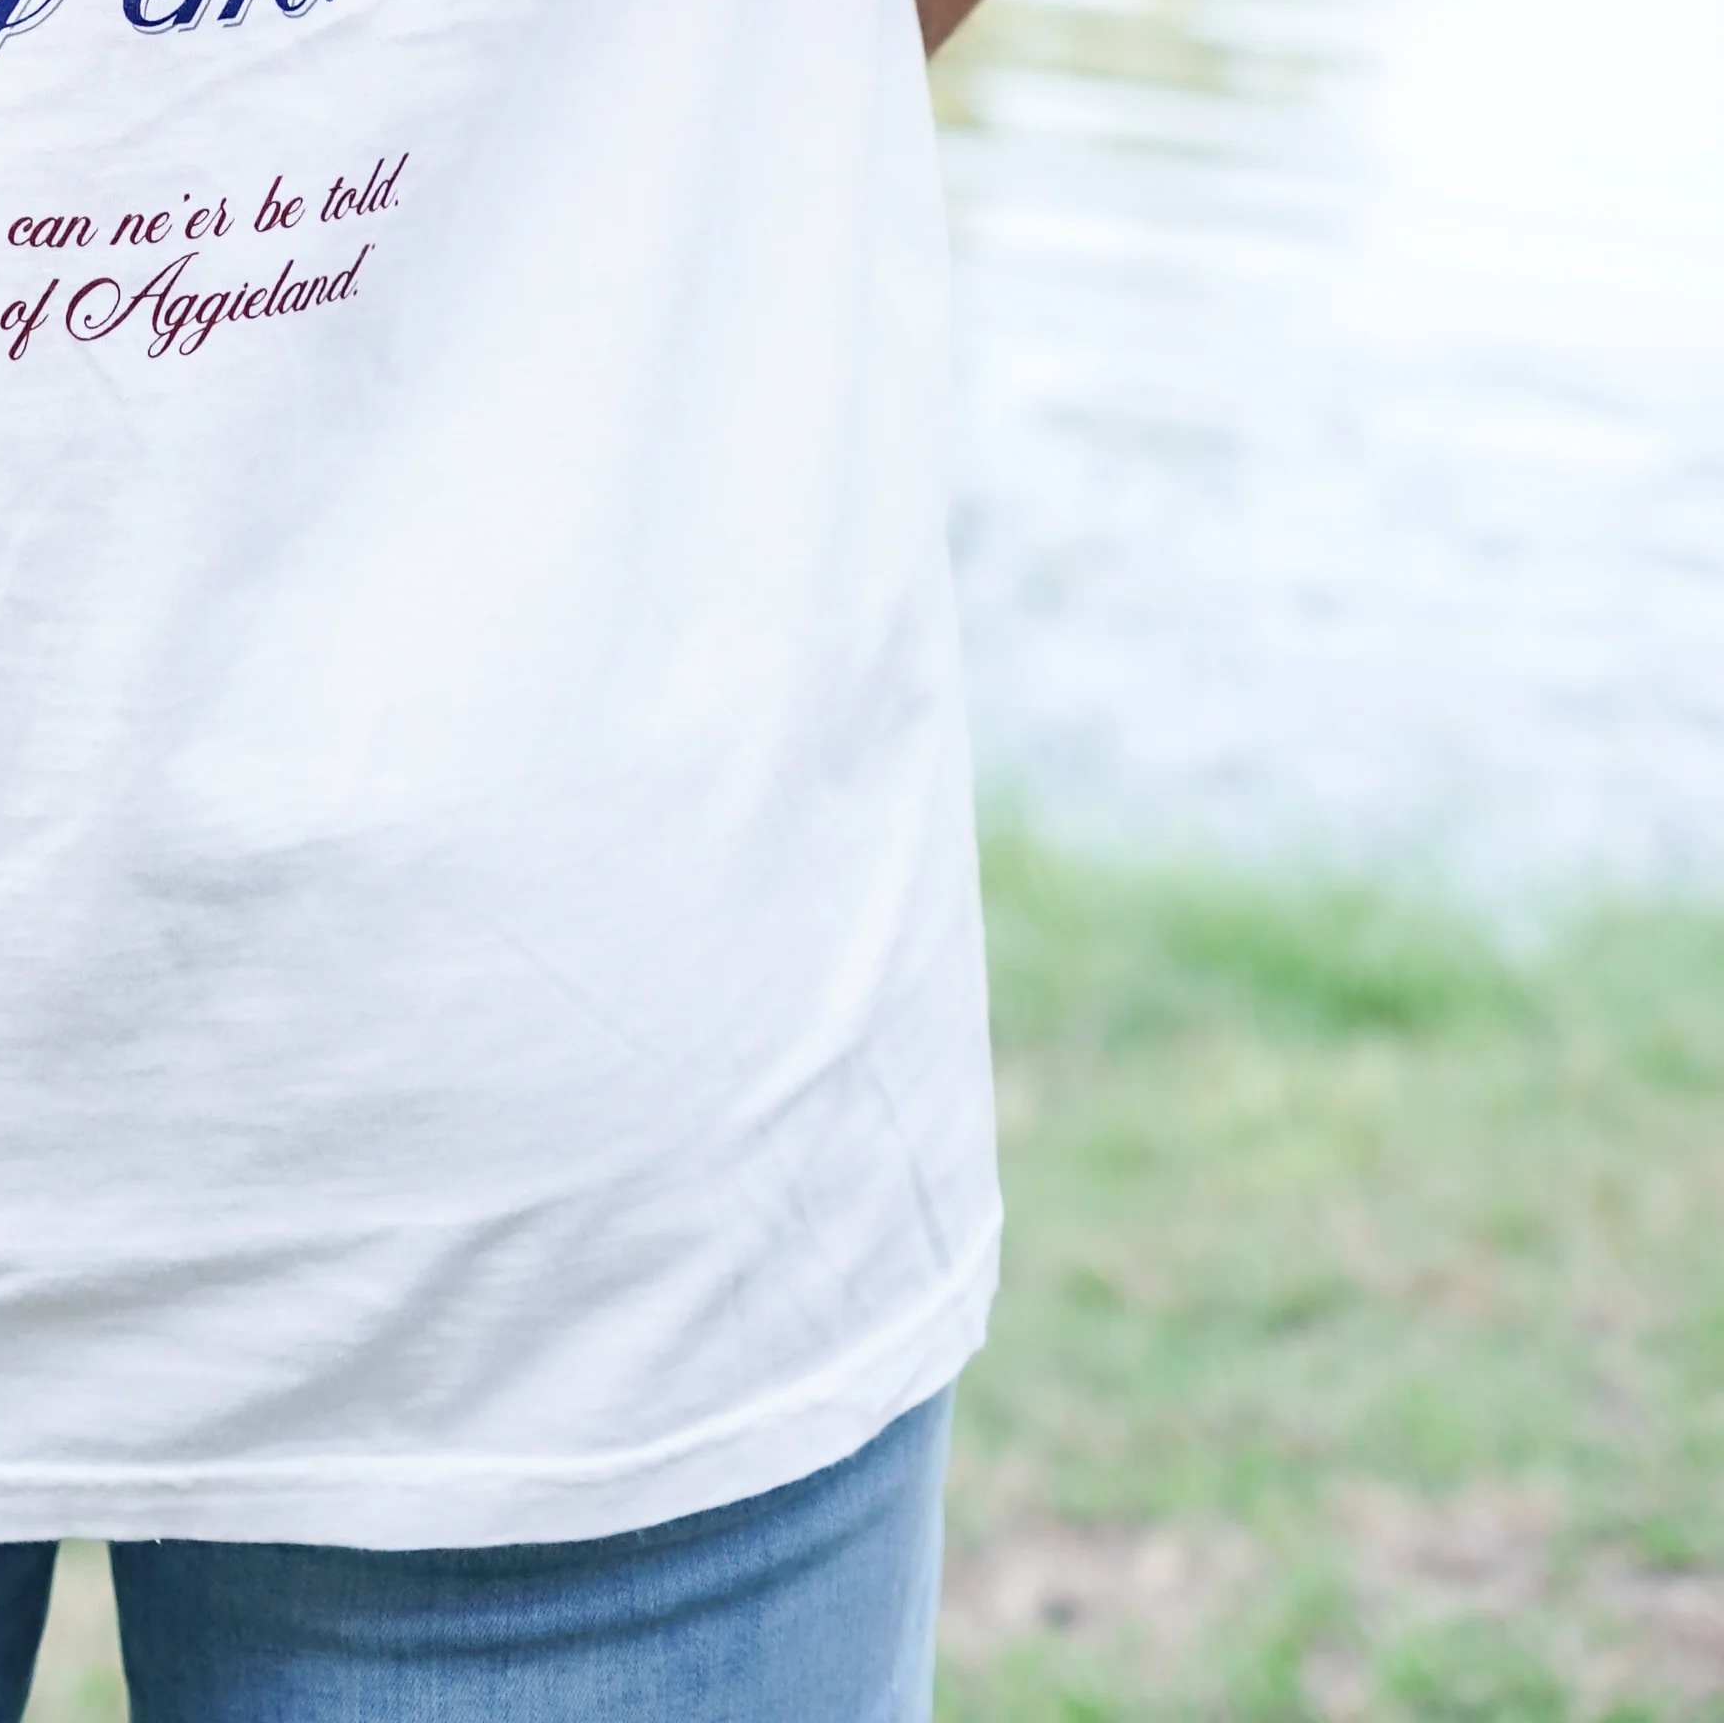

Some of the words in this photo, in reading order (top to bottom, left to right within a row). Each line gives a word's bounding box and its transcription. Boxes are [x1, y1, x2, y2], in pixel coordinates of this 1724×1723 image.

[6, 210, 100, 249] can
[109, 192, 236, 248] ne'er
[253, 174, 306, 233] be
[319, 151, 410, 223] told.
[0, 277, 60, 362] of
